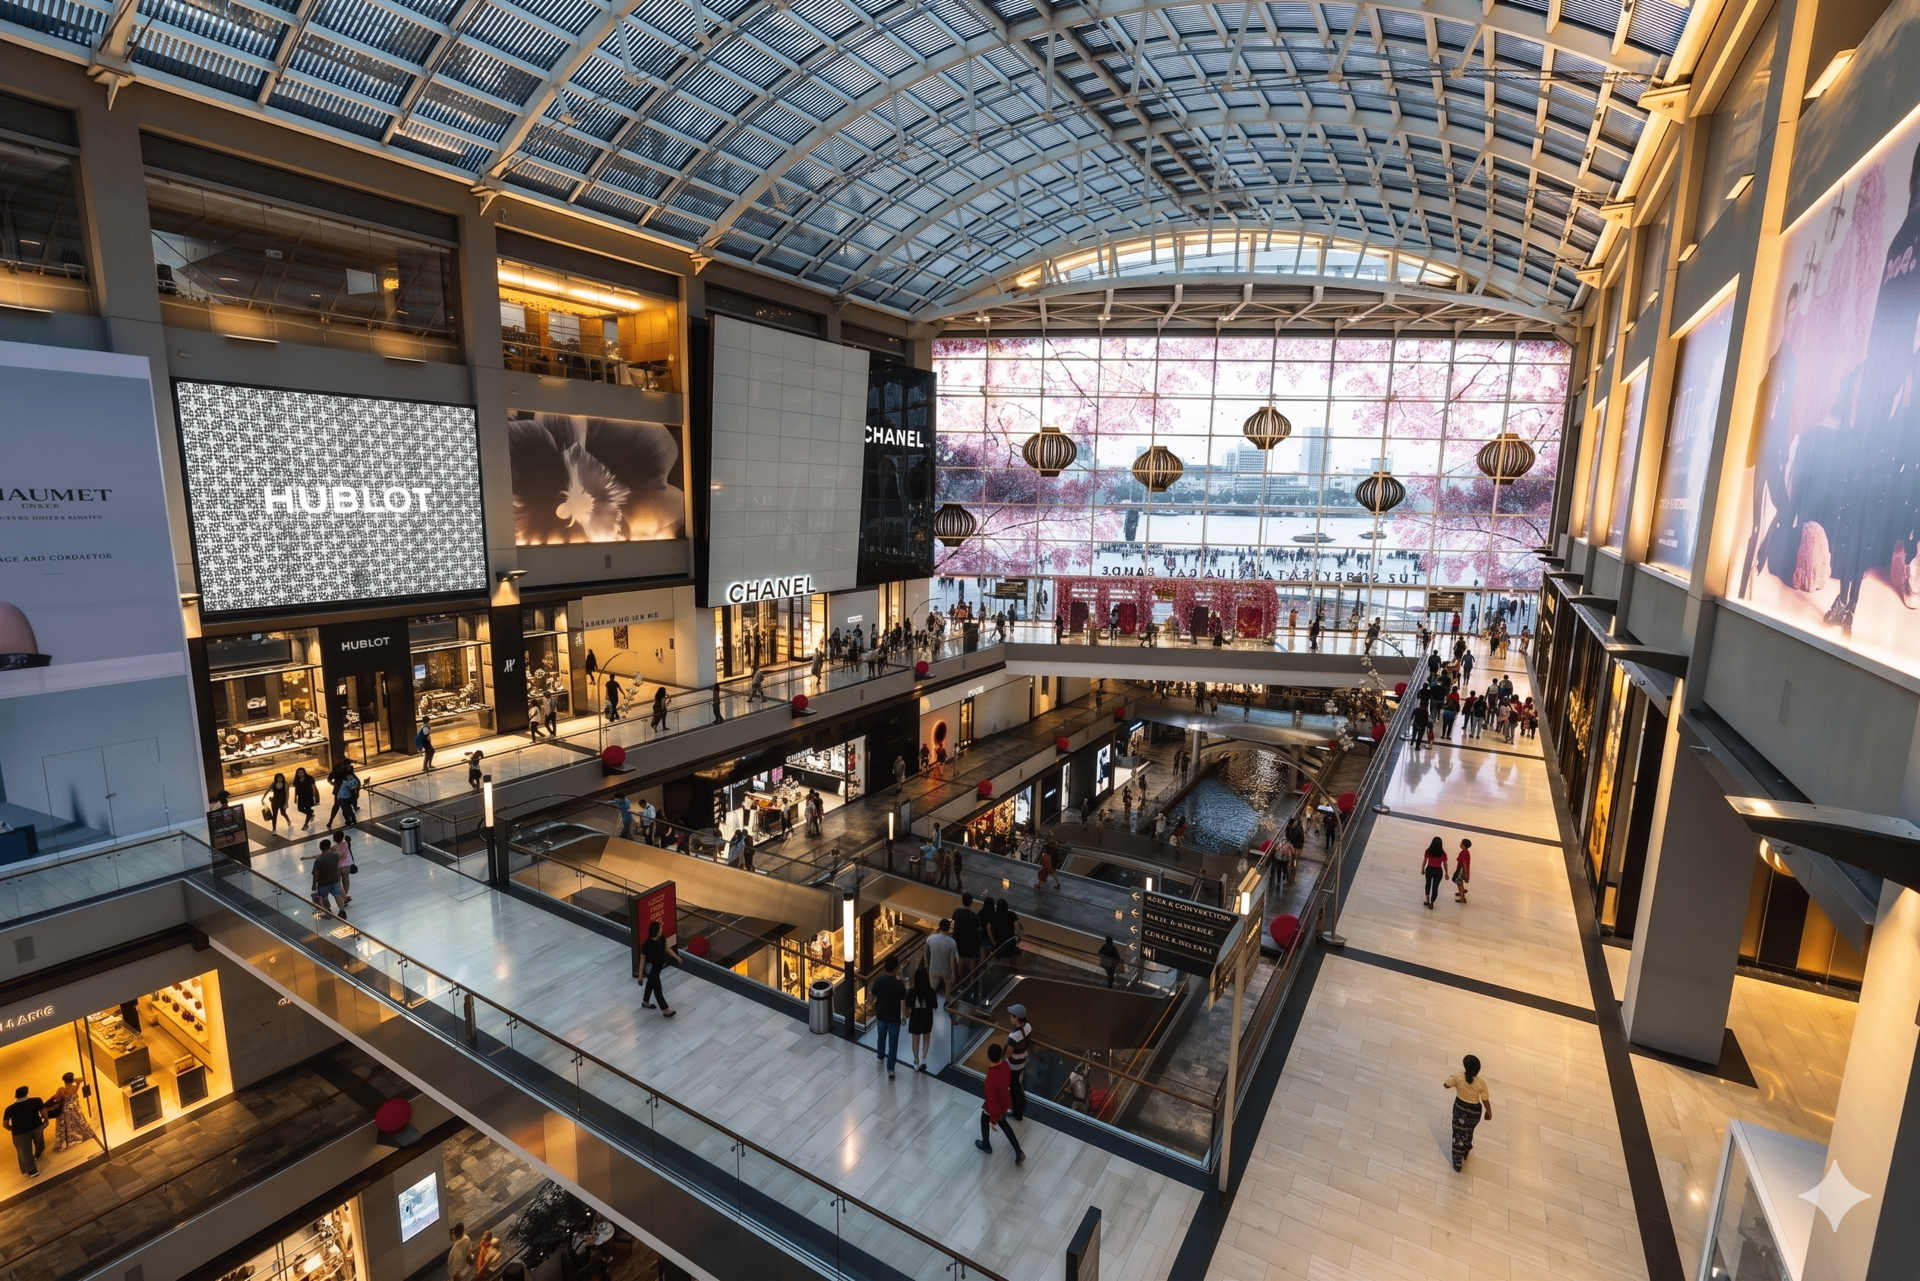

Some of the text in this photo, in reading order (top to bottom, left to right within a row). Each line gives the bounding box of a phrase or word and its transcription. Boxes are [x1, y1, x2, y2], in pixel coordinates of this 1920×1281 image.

[264, 486, 432, 514] HUBLOT
[729, 576, 816, 603] CHANEL
[341, 637, 390, 651] HUBLOT
